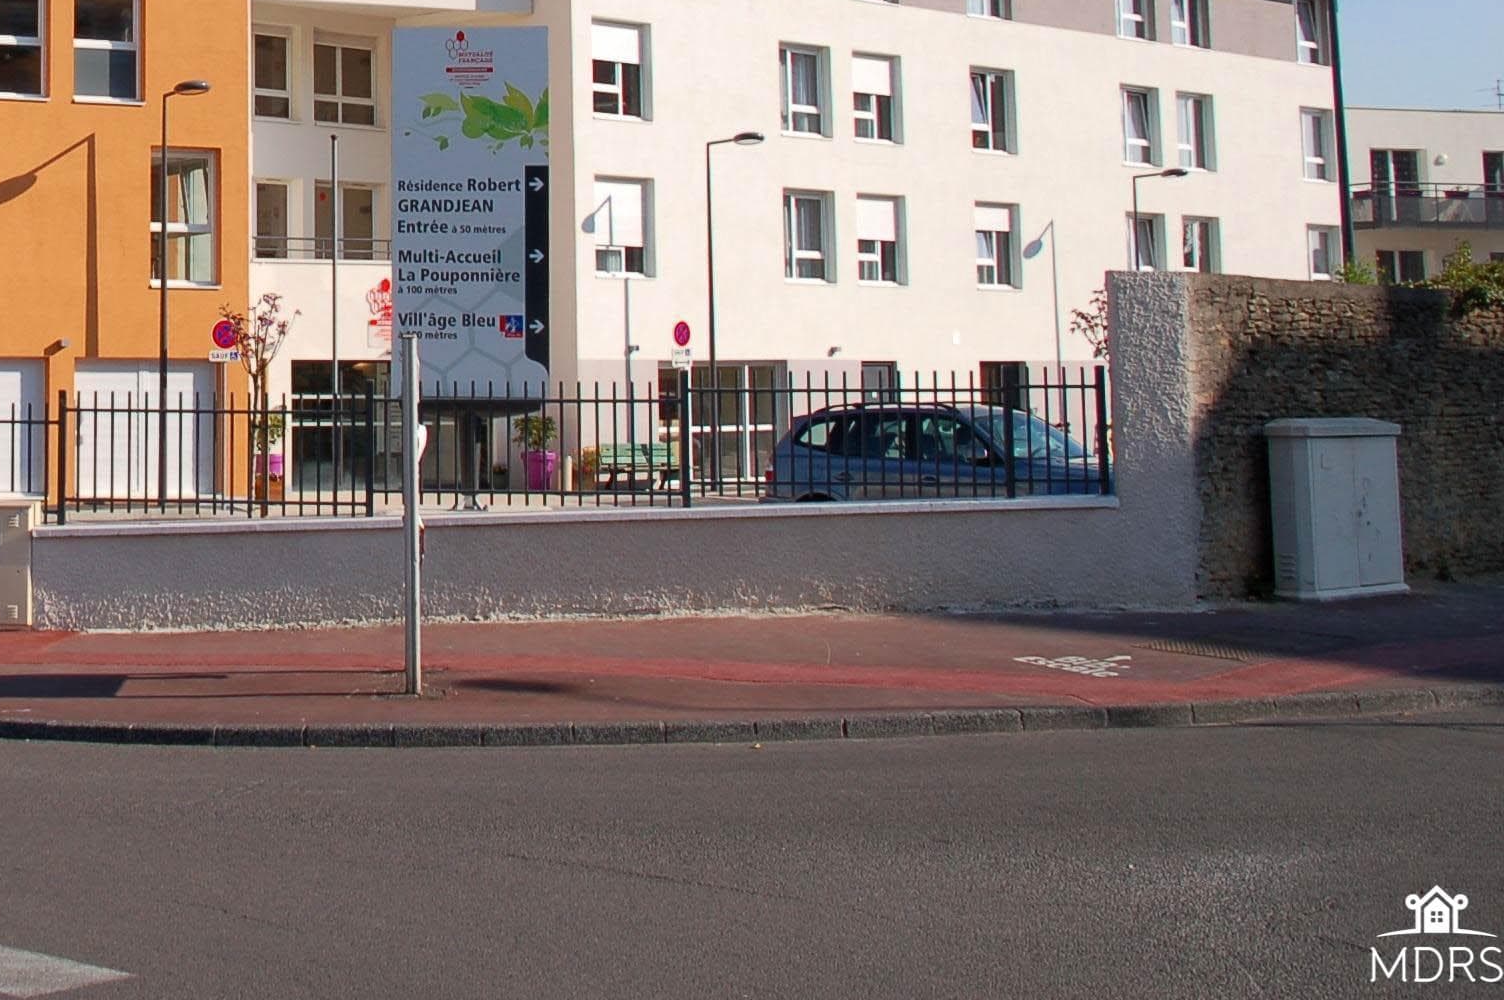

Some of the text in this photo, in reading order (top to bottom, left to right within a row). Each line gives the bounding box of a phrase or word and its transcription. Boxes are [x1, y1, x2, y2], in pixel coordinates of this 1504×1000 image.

[397, 178, 521, 192] Résidence Robert
[397, 199, 494, 213] GRANDJEAN
[397, 220, 506, 234] Entrée à 50 mètres
[397, 249, 501, 264] Multi-Accueil
[397, 268, 521, 285] La Pouponnière
[397, 286, 458, 295] à 100 mètres
[397, 313, 496, 330] Vill'âge Bleu
[424, 331, 458, 340] mètres
